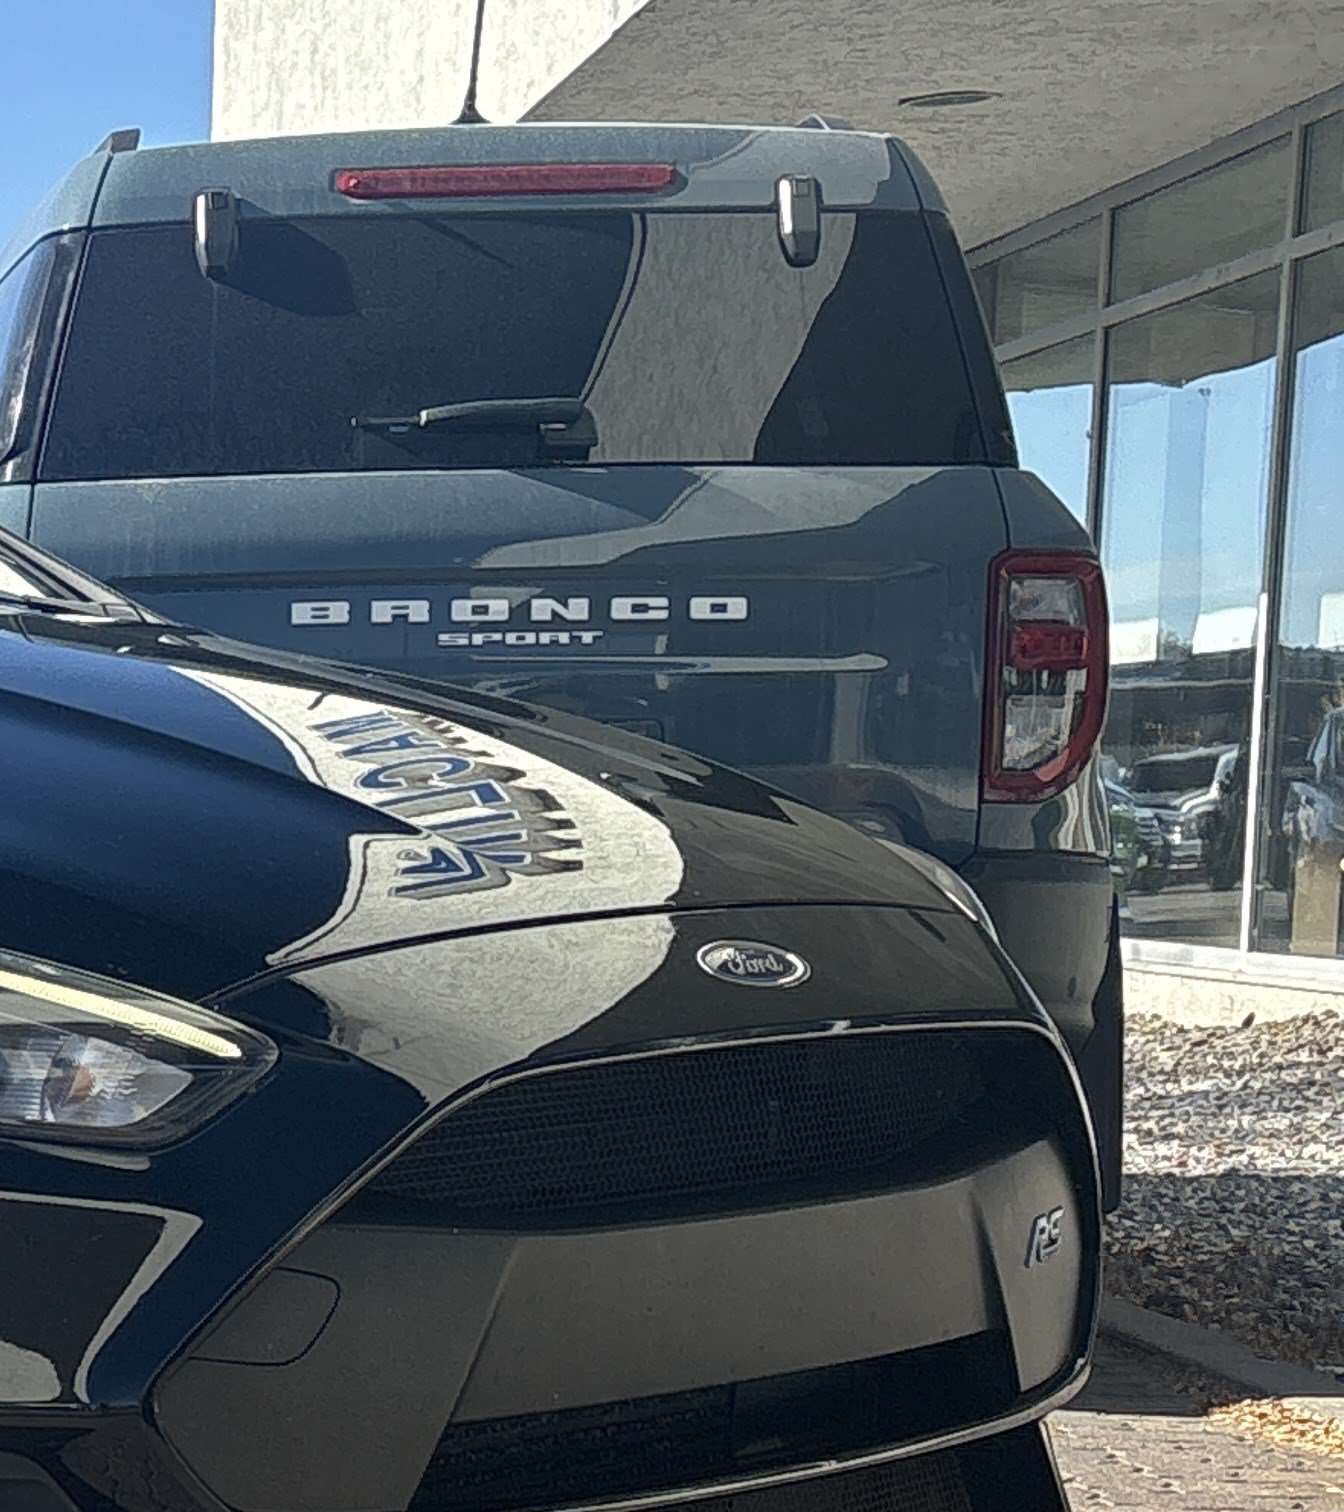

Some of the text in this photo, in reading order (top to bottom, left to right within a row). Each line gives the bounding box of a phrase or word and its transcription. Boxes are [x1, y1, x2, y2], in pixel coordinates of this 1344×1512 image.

[291, 597, 748, 625] BRONCO
[436, 630, 603, 647] SPORT
[1023, 1204, 1064, 1268] RS
